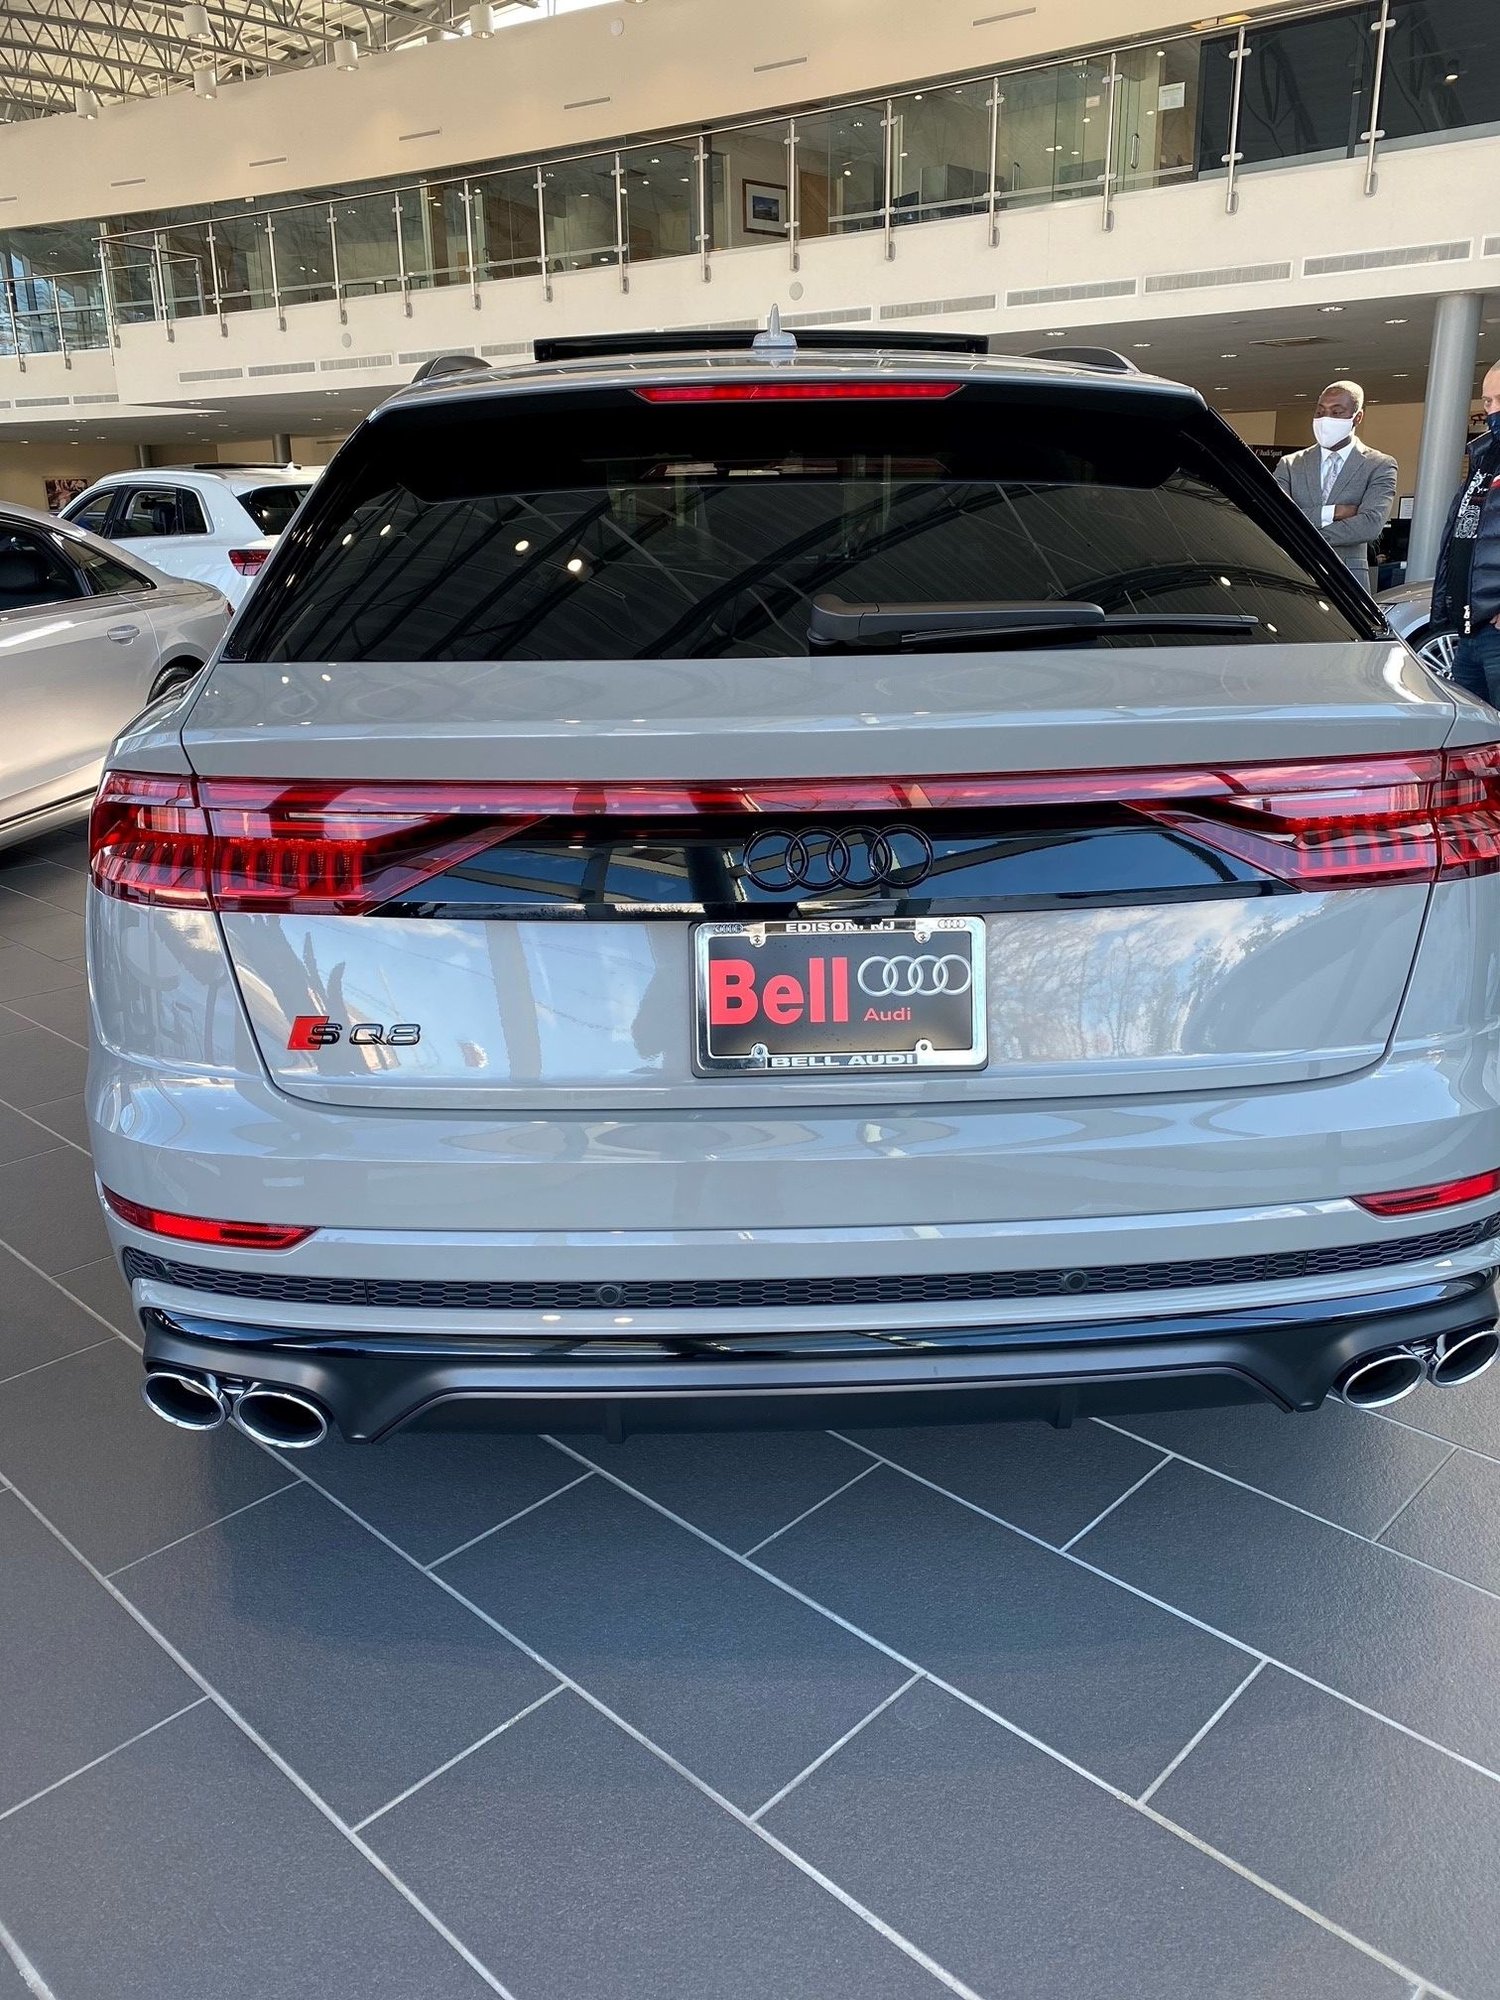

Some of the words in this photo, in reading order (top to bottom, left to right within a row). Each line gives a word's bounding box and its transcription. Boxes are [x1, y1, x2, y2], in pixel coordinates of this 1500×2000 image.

[710, 957, 848, 1025] Bell
[863, 1007, 911, 1021] Audi
[771, 1055, 840, 1067] BELL
[848, 1054, 914, 1066] AUDI
